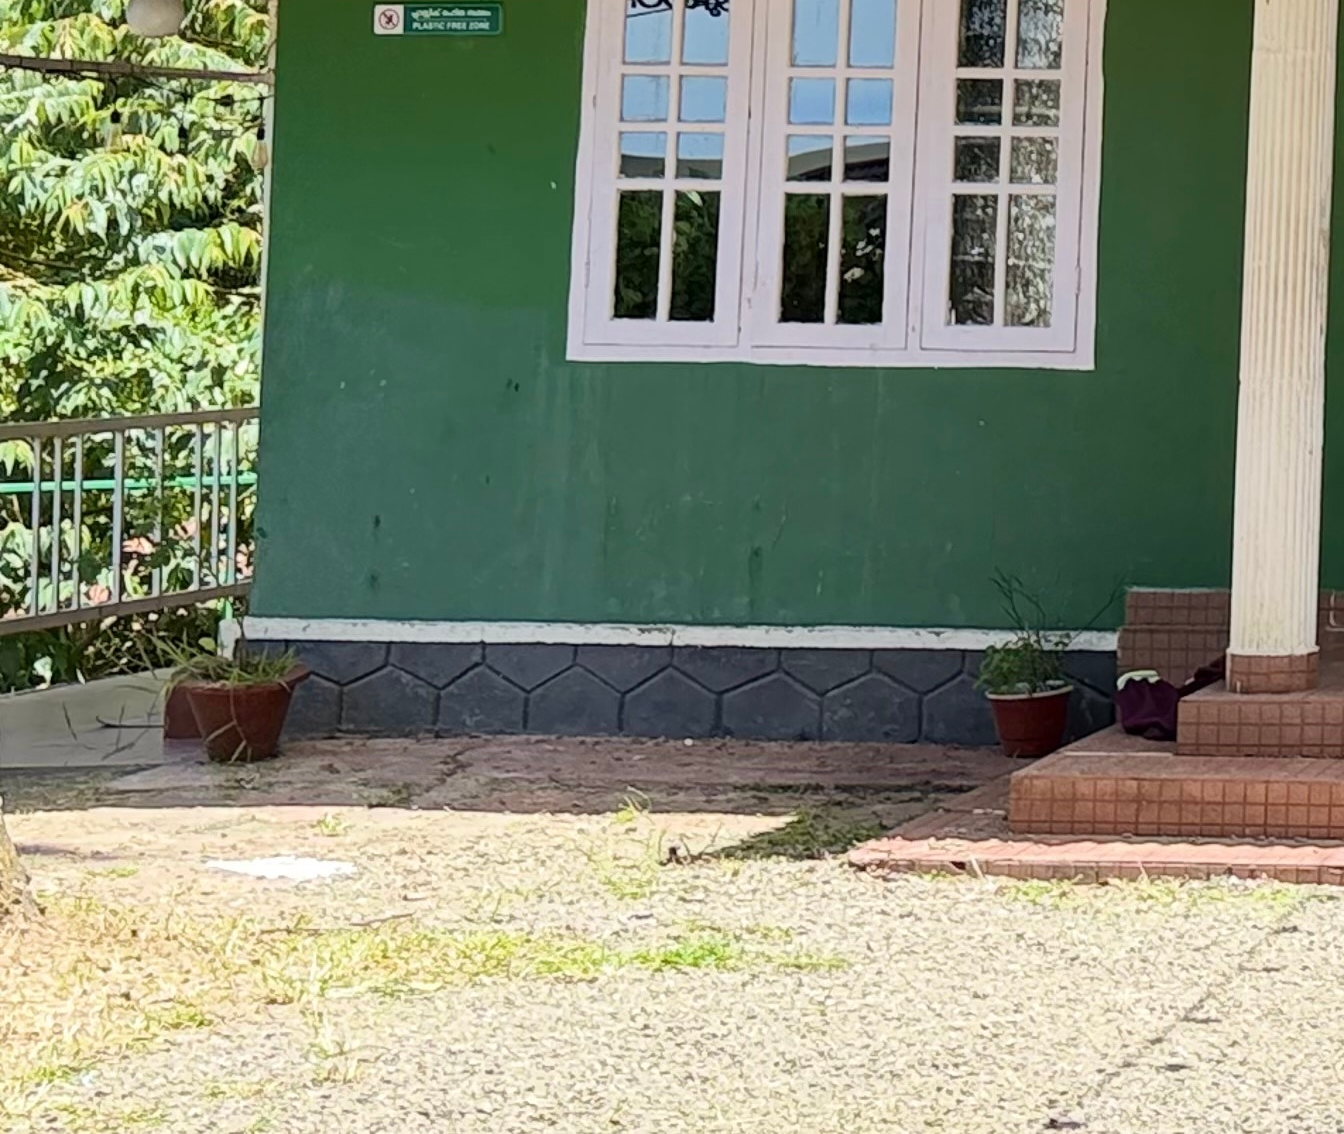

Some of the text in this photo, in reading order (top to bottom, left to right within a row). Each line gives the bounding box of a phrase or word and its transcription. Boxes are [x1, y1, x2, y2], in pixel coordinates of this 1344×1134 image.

[412, 21, 490, 30] PLASTIC FREE ZONE
